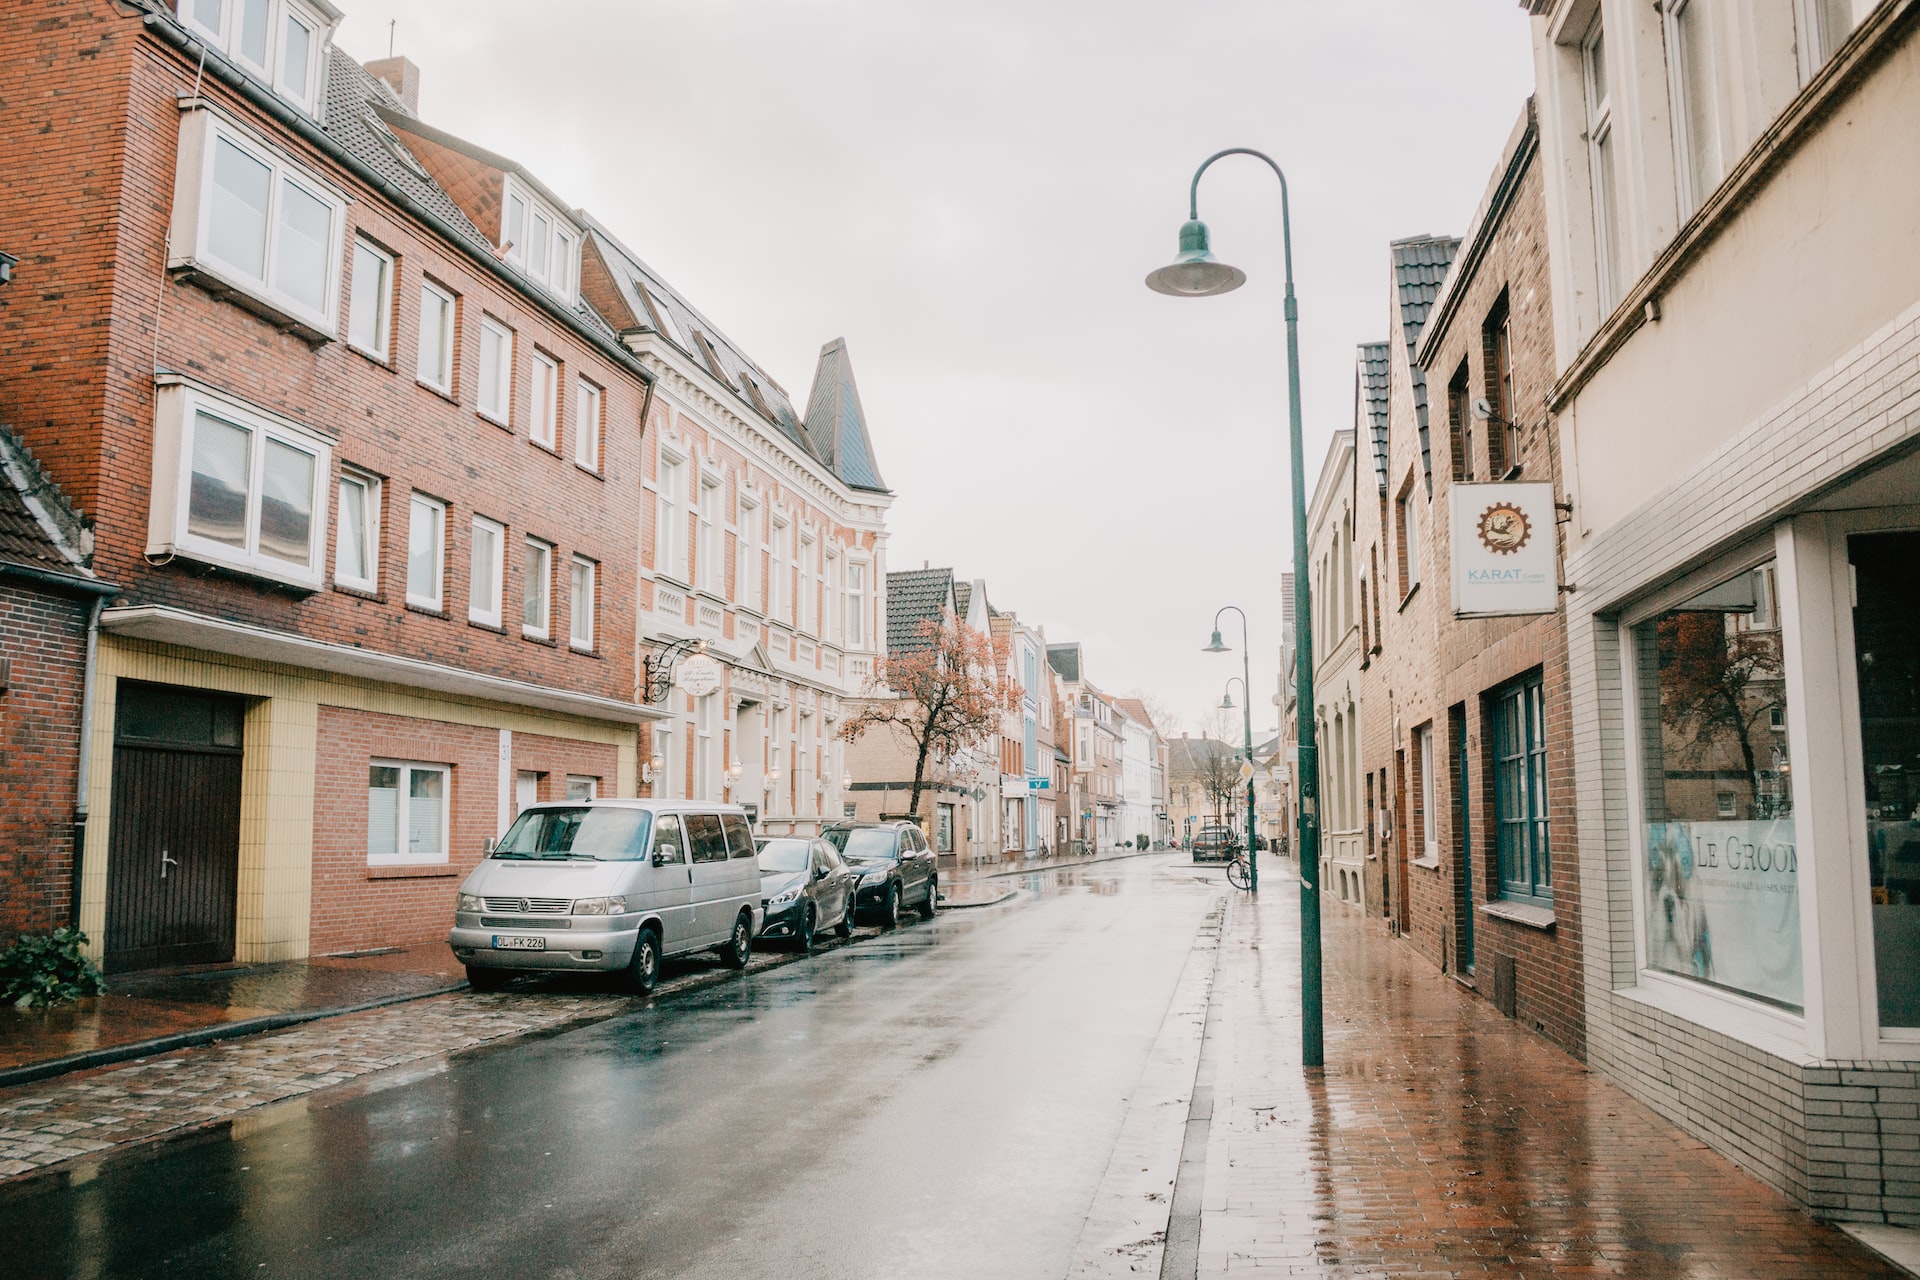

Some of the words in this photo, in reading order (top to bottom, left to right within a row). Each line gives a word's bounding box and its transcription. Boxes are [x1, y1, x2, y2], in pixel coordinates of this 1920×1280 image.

[1468, 569, 1522, 580] KARAT
[498, 937, 508, 946] OL
[513, 938, 525, 948] FK
[527, 938, 543, 948] 226
